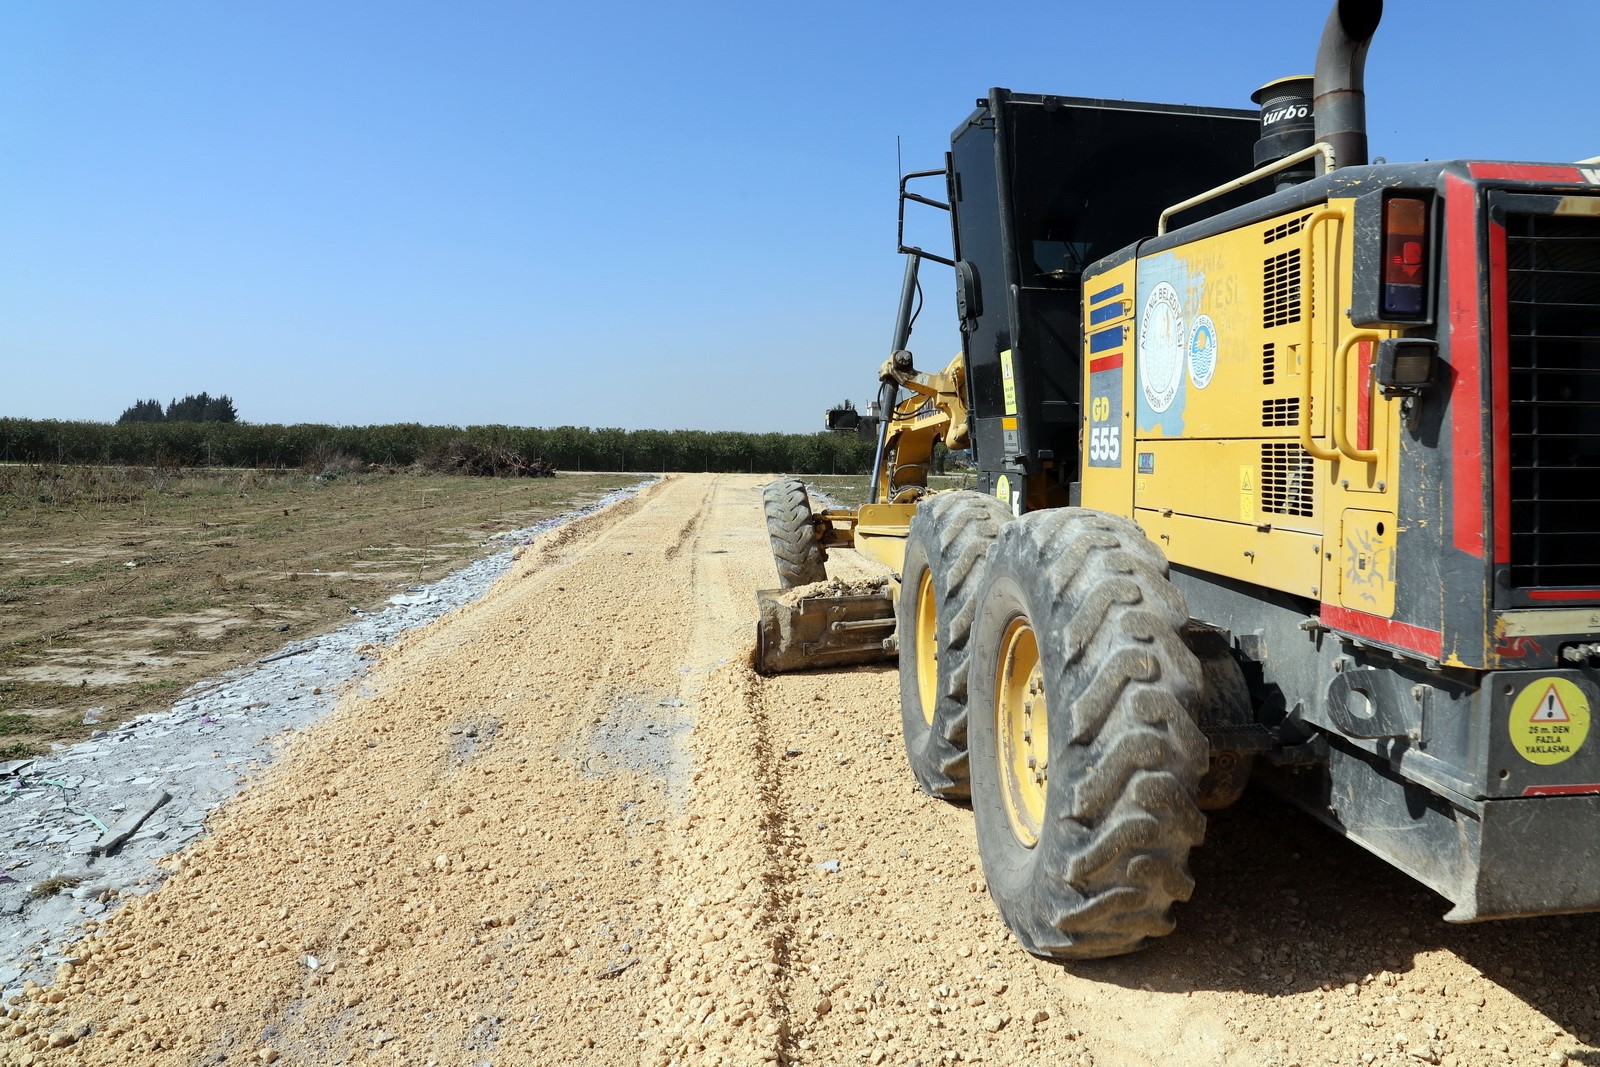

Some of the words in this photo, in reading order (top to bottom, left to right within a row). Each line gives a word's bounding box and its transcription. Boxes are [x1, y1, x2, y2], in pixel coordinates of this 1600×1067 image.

[1263, 105, 1308, 126] turbo
[1092, 396, 1110, 423] GD
[1090, 426, 1120, 461] 555
[1528, 725, 1540, 734] 25
[1552, 725, 1570, 734] DEN
[1535, 735, 1562, 744] FAZLA
